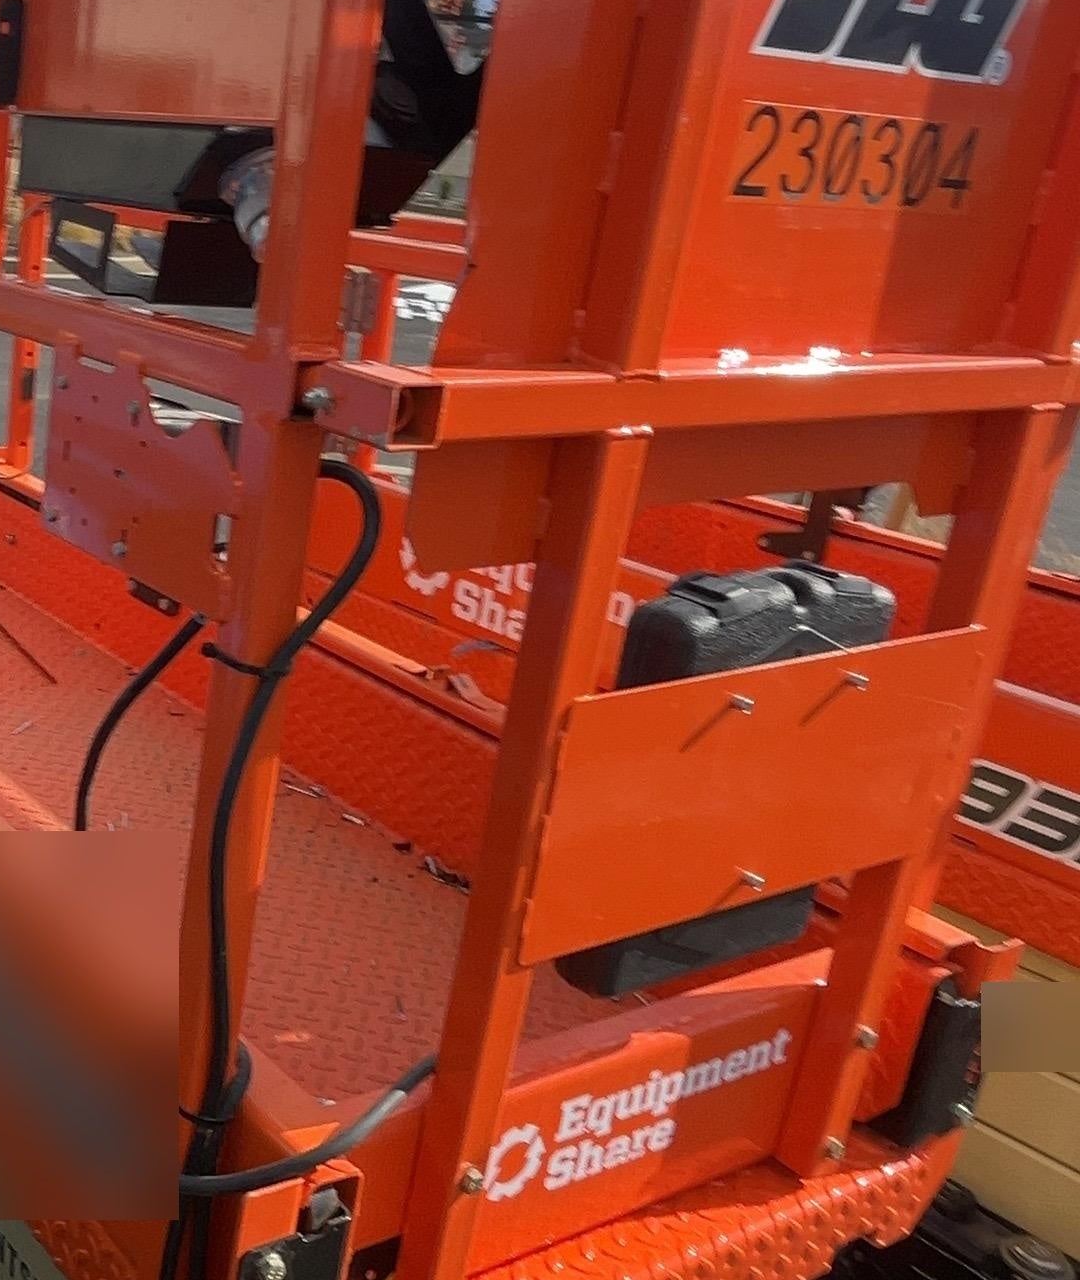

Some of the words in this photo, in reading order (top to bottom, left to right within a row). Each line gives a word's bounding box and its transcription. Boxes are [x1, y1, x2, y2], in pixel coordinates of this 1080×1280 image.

[732, 104, 982, 208] 230304
[450, 577, 528, 643] Sha
[553, 1027, 794, 1143] Equipment
[542, 1118, 678, 1192] Share
